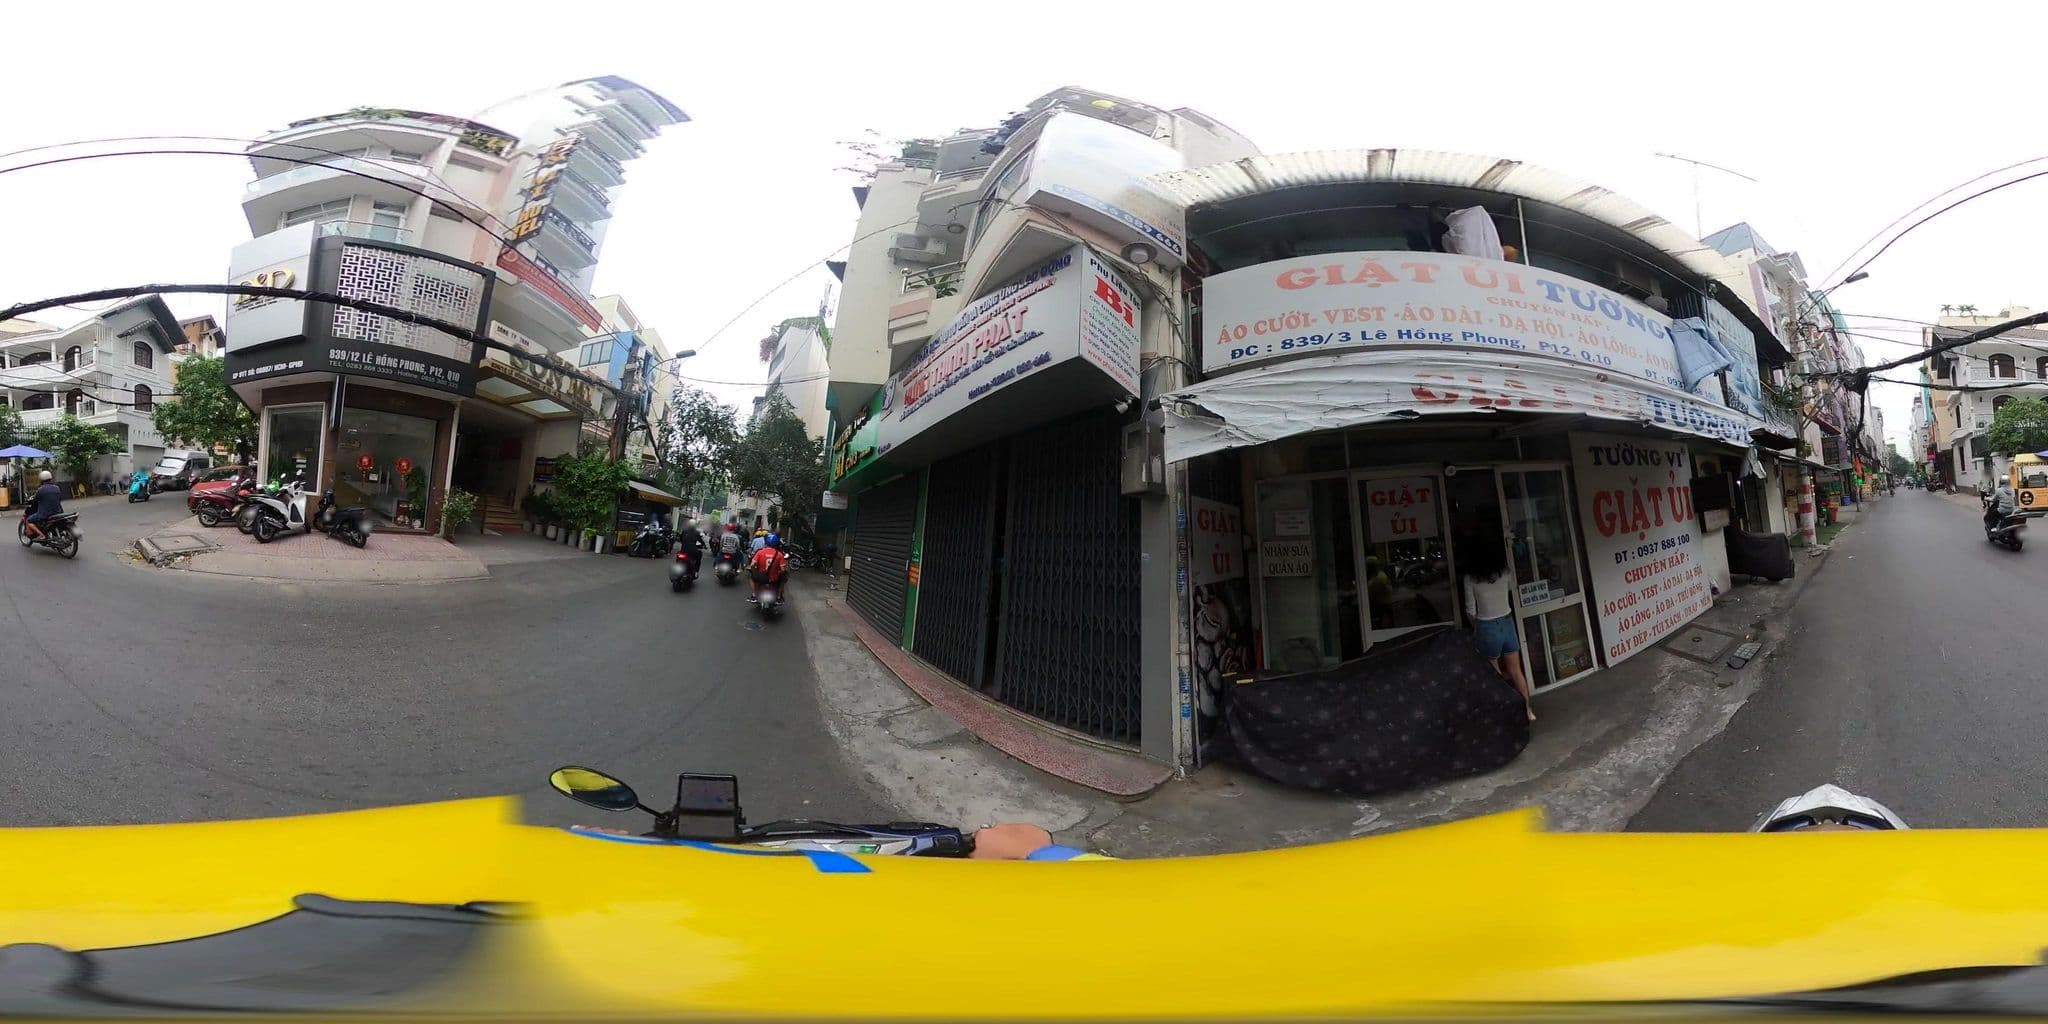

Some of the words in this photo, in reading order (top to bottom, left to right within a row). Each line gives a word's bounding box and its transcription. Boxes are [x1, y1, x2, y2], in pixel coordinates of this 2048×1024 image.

[1093, 274, 1135, 329] Bi
[1275, 256, 1441, 290] GIẶT
[1462, 258, 1526, 294] ỦI
[1535, 278, 1666, 340] TƯỜNG
[1486, 295, 1567, 318] CHUYÊN
[972, 305, 1029, 360] PHÁT
[1217, 321, 1248, 345] ÁO
[1323, 305, 1386, 324] VEST
[1440, 305, 1483, 325] DÀI
[1230, 345, 1259, 360] ĐC
[1360, 328, 1388, 341] Lê
[1396, 328, 1453, 344] Hồng
[329, 349, 361, 362] 839/12
[362, 351, 373, 364] LÊ
[375, 353, 399, 369] HỒNG
[399, 359, 427, 375] PHONG,
[429, 365, 445, 379] P12,
[446, 370, 461, 383] Q10
[1589, 442, 1661, 466] TƯỜNG
[1371, 483, 1430, 508] GIẶT
[1593, 475, 1664, 541] GIẶT
[1667, 470, 1694, 523] ỦI
[1614, 550, 1628, 564] ĐT
[1637, 542, 1659, 558] 0937
[1661, 537, 1676, 550] 888
[1677, 533, 1690, 544] 100
[1296, 560, 1309, 574] ÁO
[1624, 558, 1667, 584] CHUYÊN
[1603, 600, 1617, 617] ÁO
[1617, 591, 1637, 609] CƯỚI
[1640, 584, 1658, 600] VEST
[1618, 617, 1630, 634] ÁO
[1630, 608, 1652, 627] LÔNG
[1655, 600, 1665, 616] ÁO
[1610, 637, 1631, 658] GIÀY
[1633, 629, 1648, 647] DÉP
[1651, 620, 1666, 637] TÚI
